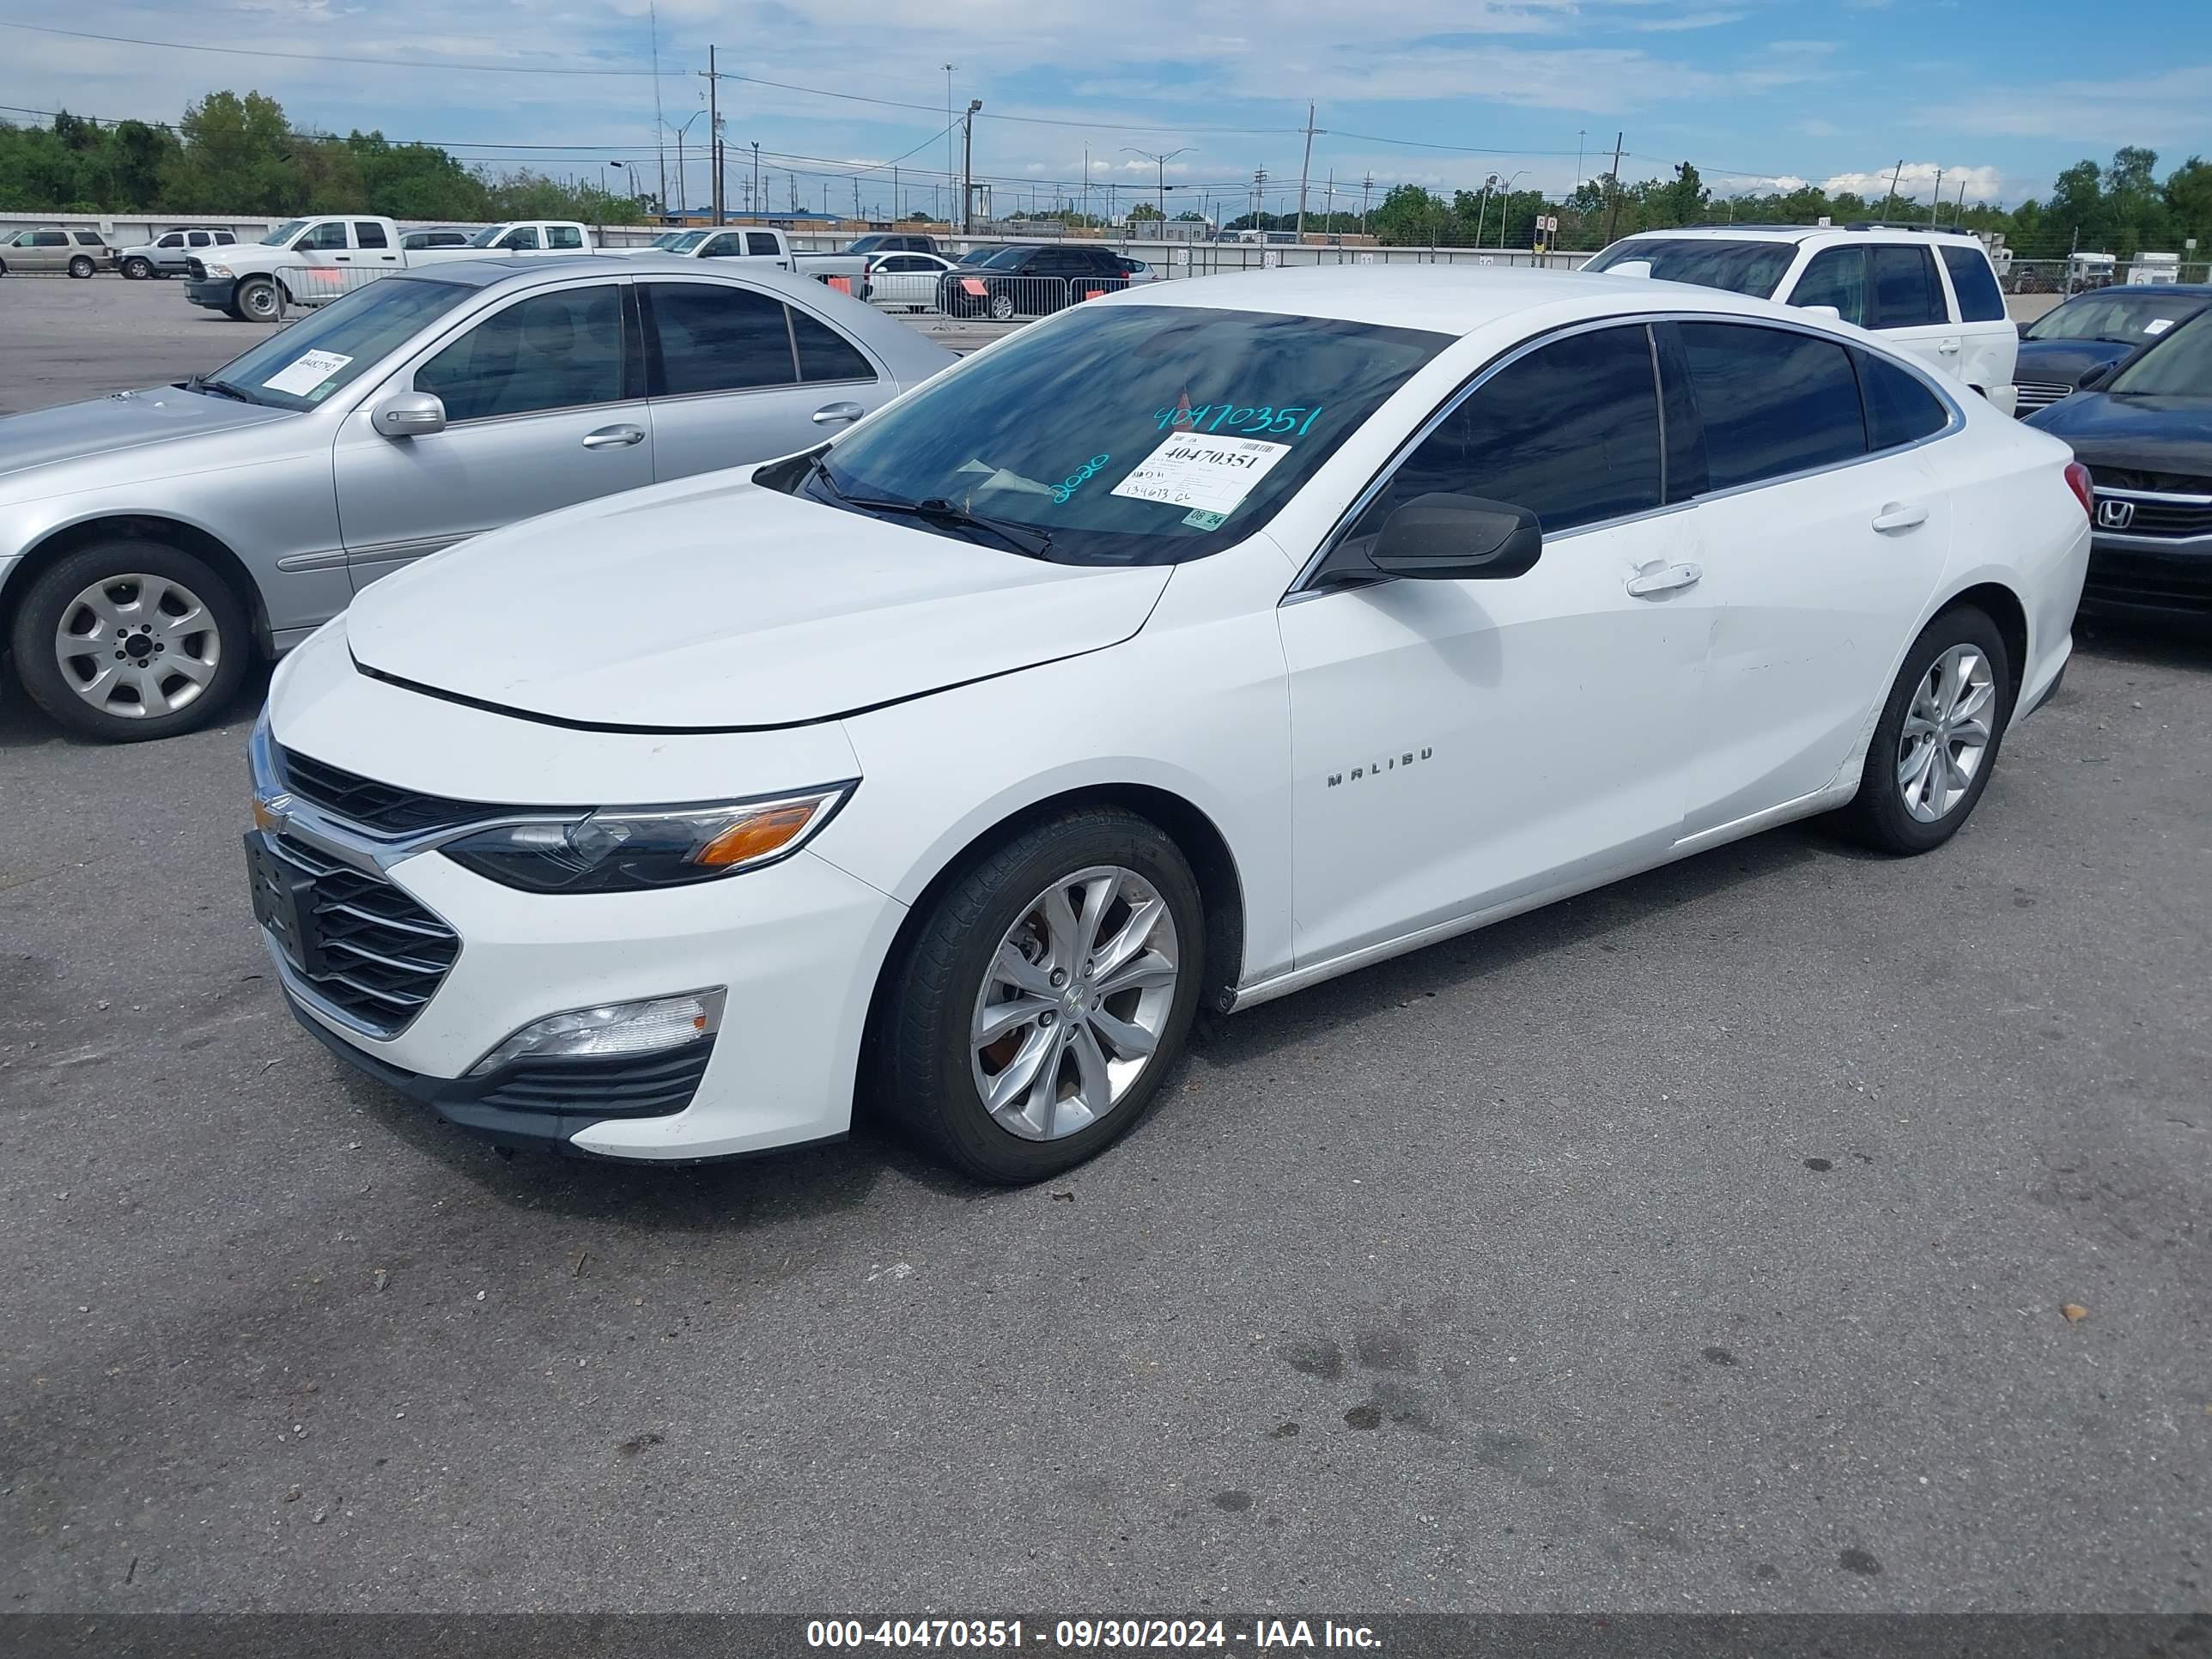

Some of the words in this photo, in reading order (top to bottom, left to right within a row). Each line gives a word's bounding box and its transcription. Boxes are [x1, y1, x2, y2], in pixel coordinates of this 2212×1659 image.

[1178, 252, 1187, 263] 13
[1266, 254, 1275, 264] 12
[2135, 273, 2144, 285] 6
[1153, 404, 1322, 436] 40470351
[1164, 447, 1260, 470] 40470351
[1048, 453, 1109, 504] 2020
[1190, 510, 1206, 520] 08
[1206, 514, 1223, 525] 24
[1328, 746, 1433, 788] MALIBU
